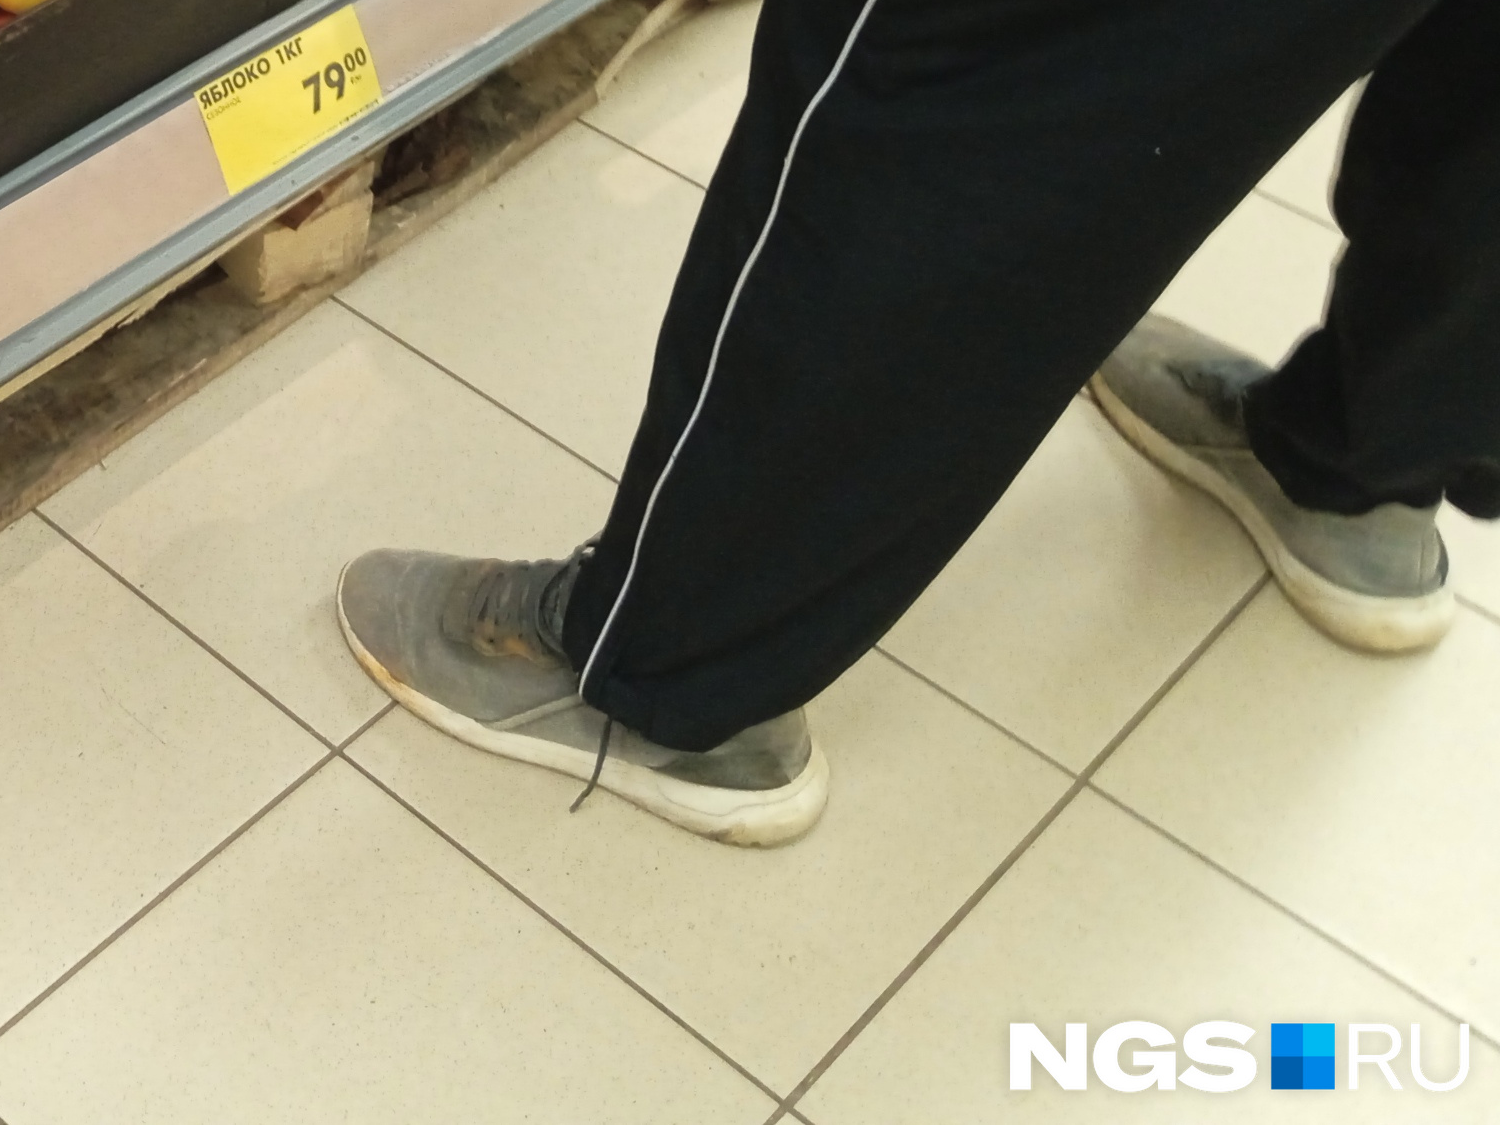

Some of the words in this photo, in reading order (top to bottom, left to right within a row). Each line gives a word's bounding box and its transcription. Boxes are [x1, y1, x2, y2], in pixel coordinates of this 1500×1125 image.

[199, 57, 271, 110] ЯБЛОКО
[275, 37, 303, 65] 1КГ
[302, 61, 346, 115] 79
[343, 46, 367, 72] 00
